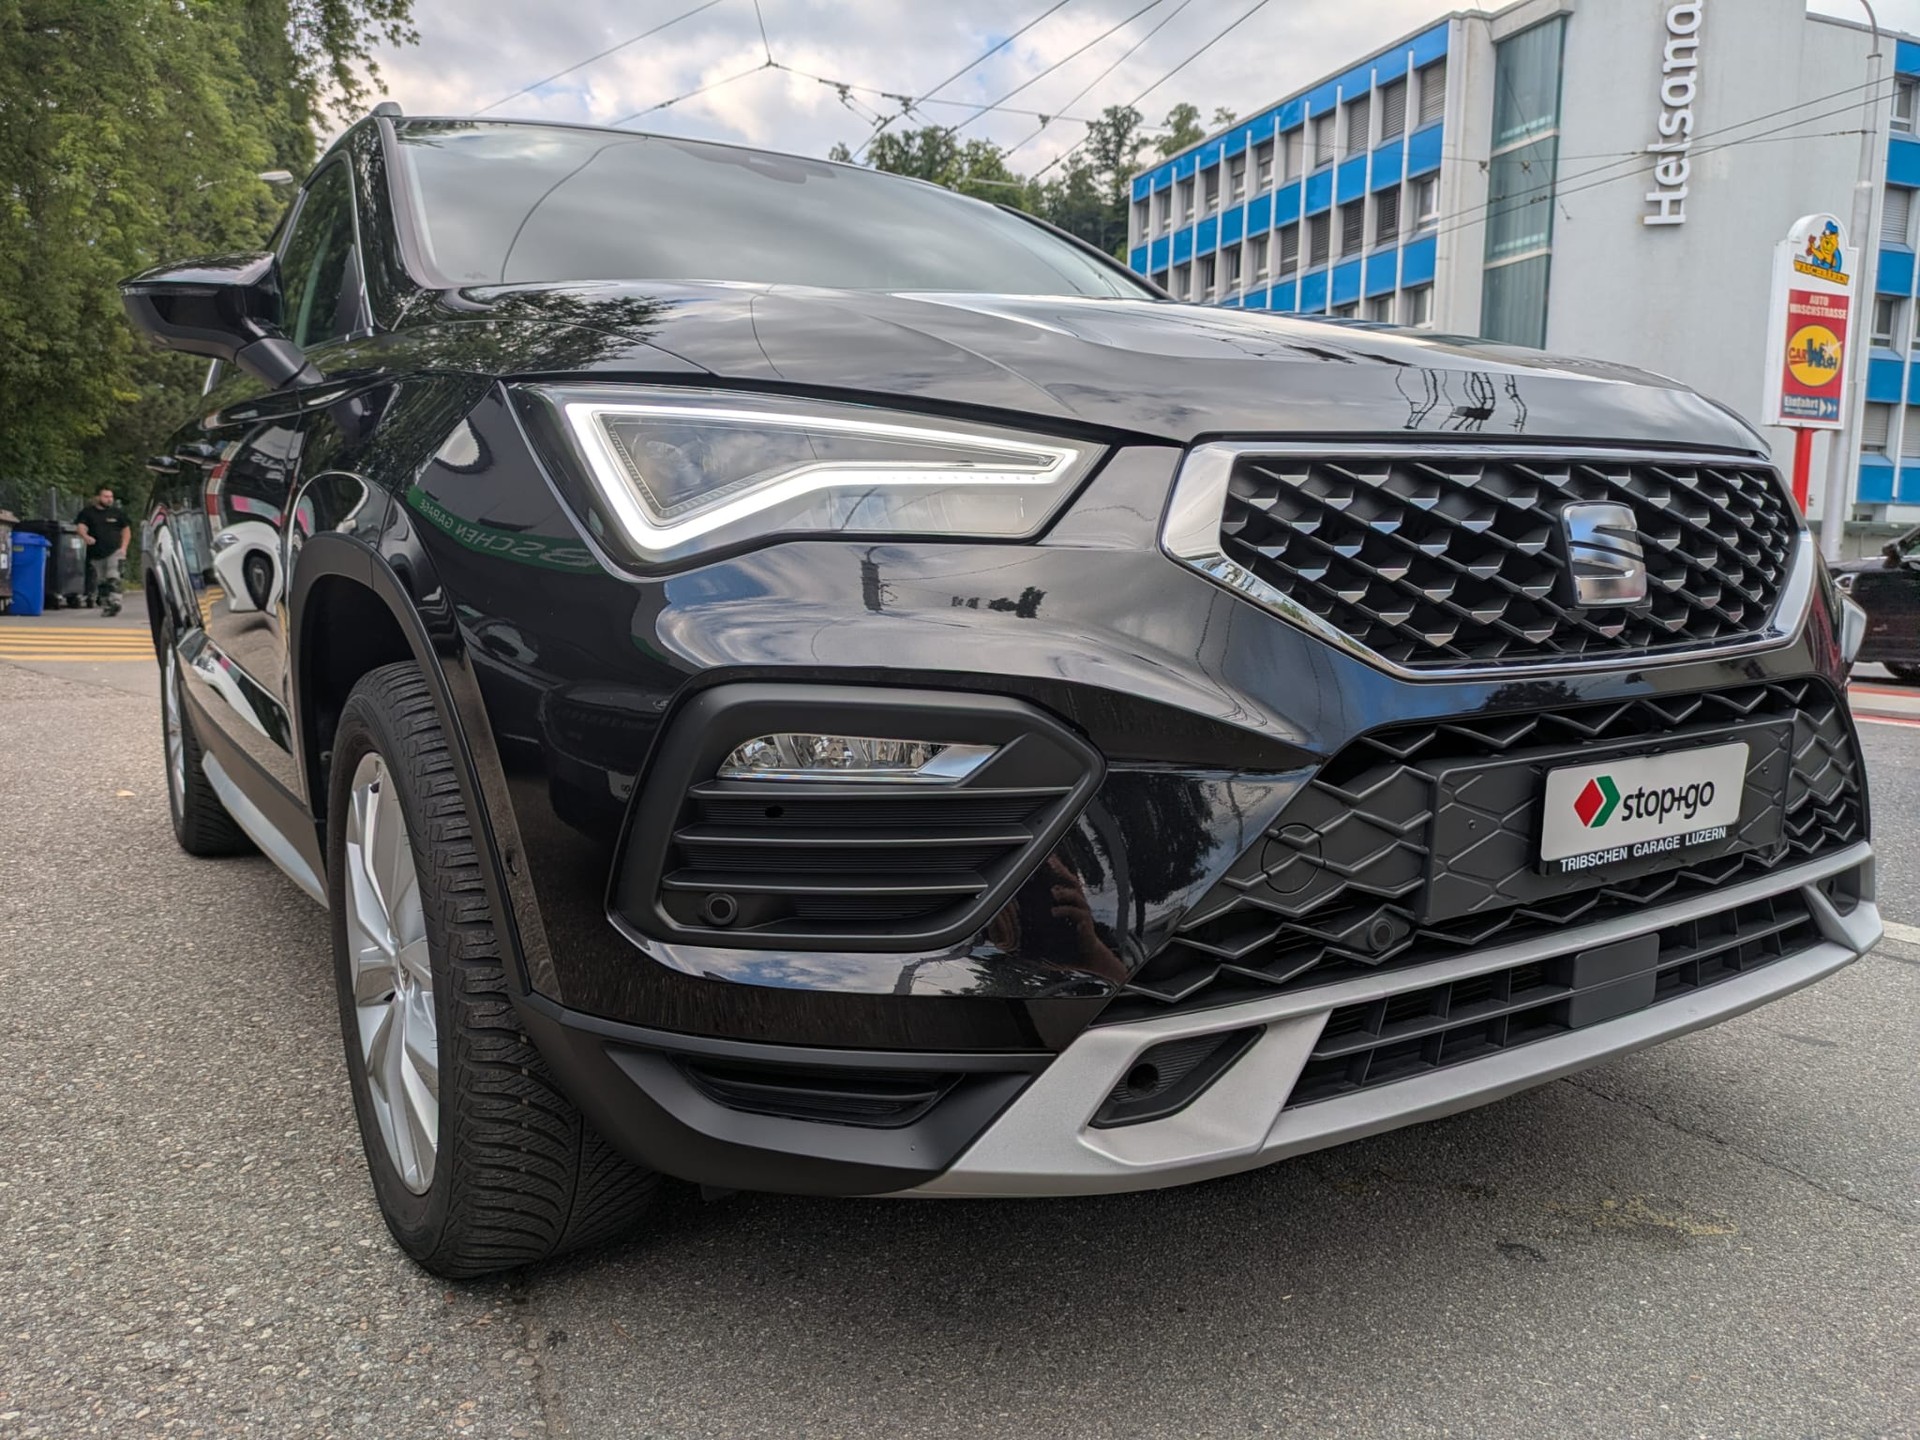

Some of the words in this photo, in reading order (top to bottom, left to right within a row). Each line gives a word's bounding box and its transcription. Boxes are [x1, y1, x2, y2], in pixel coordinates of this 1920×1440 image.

[1643, 0, 1703, 226] Helsana
[1789, 303, 1847, 319] WASCHSTRASSE
[1809, 294, 1829, 306] AUTO
[1784, 395, 1819, 409] Einfahrt
[1621, 780, 1715, 824] stop+go
[1560, 846, 1628, 872] TRIBSCHEN
[1633, 835, 1681, 857] GARAGE
[1685, 827, 1726, 846] LUZERN
